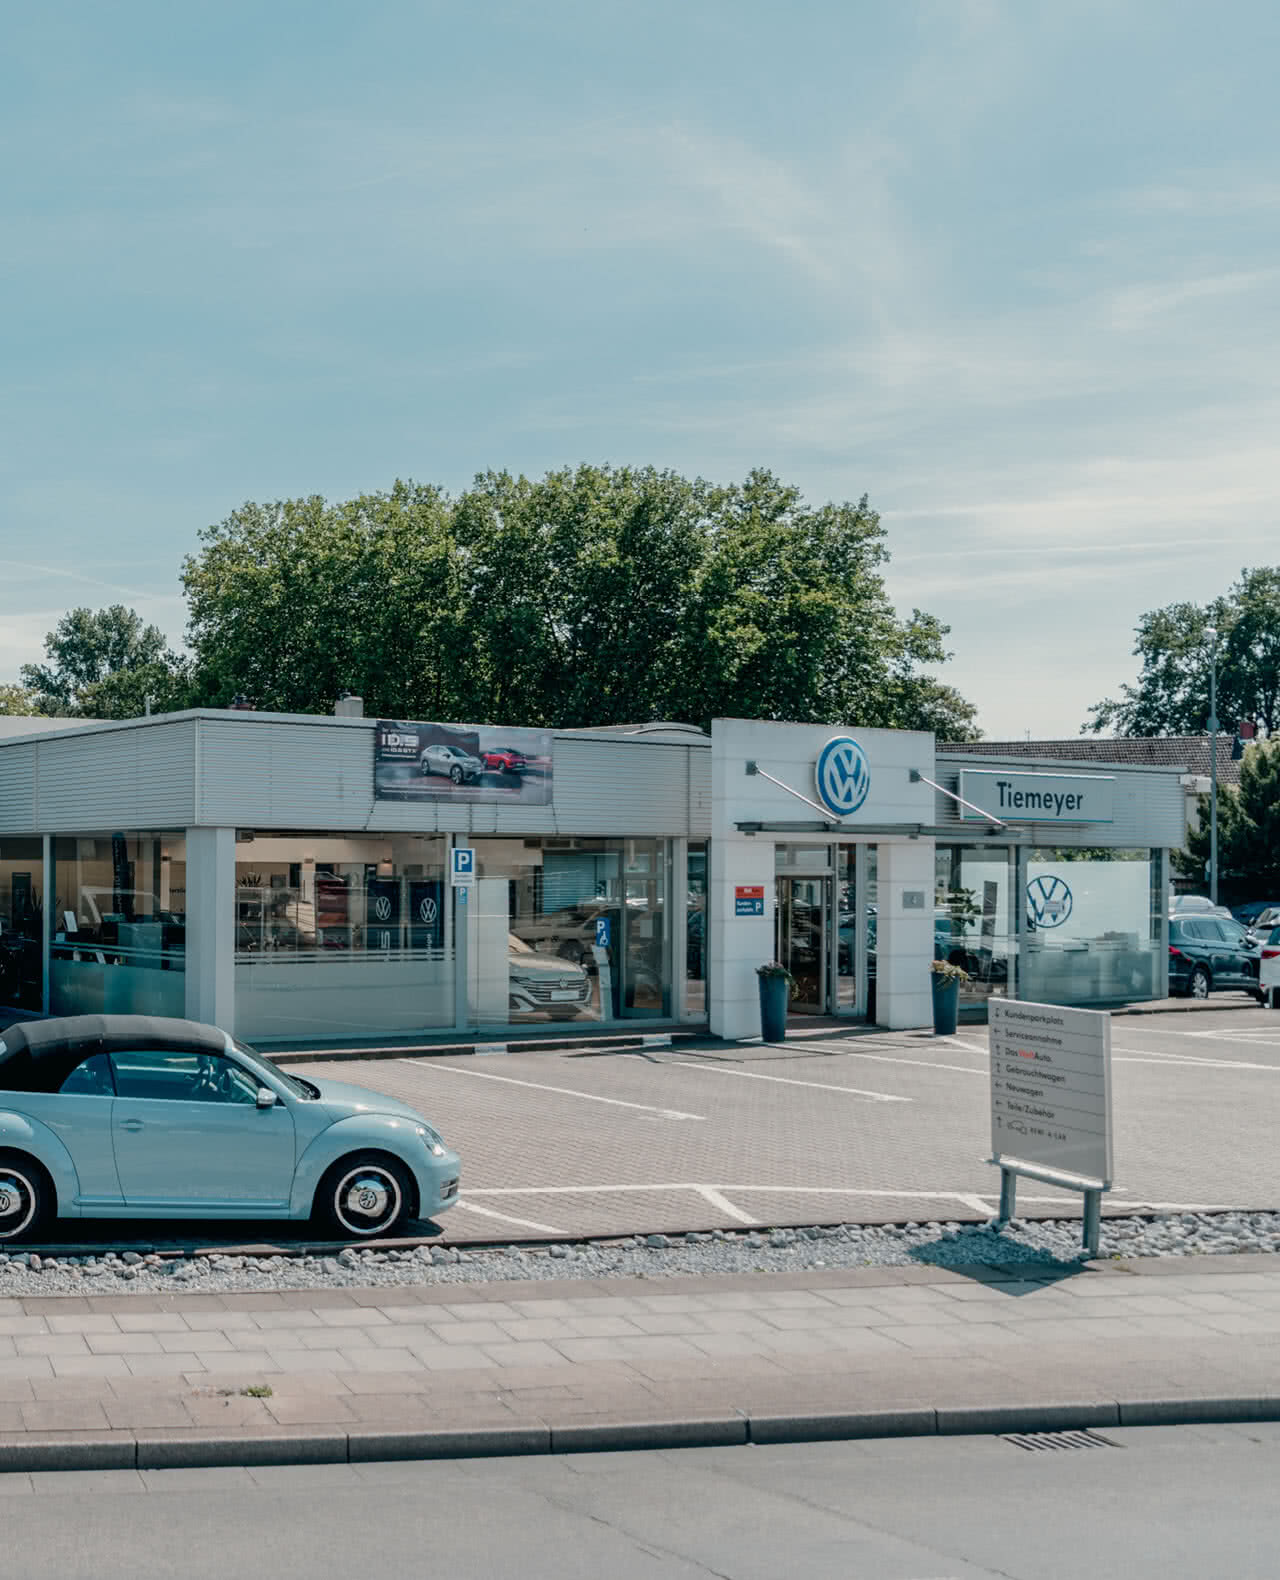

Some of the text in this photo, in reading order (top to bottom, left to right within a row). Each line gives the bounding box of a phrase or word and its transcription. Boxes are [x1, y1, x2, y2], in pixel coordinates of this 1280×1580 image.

[996, 781, 1083, 816] Tiemeyer
[457, 852, 470, 871] P
[1004, 1009, 1065, 1026] Kundenparkplatz
[1005, 1028, 1062, 1045] Serviceannahme
[1006, 1064, 1065, 1083] Gebrauchtwagen
[1006, 1082, 1044, 1097] Neuwagen
